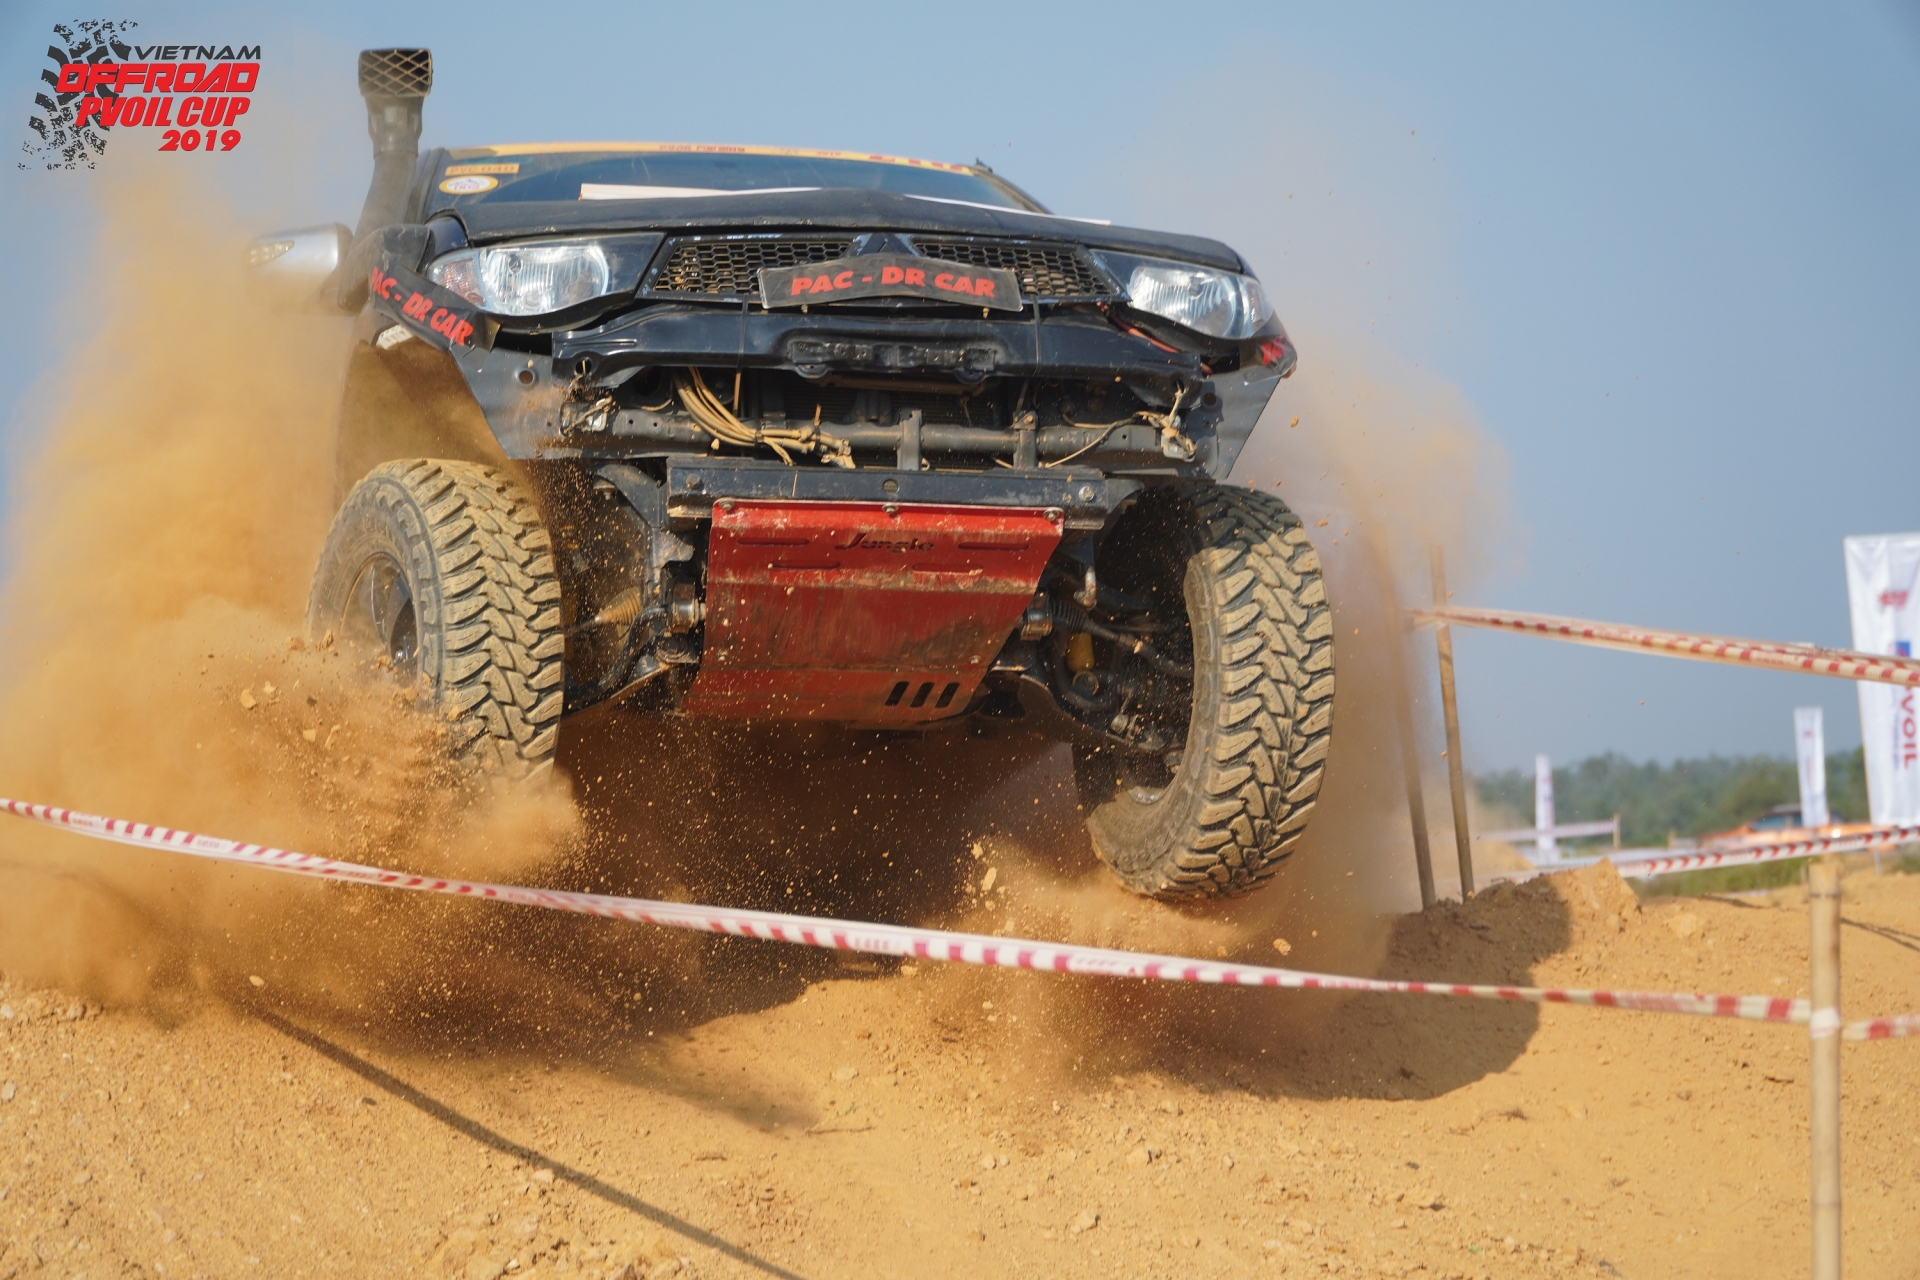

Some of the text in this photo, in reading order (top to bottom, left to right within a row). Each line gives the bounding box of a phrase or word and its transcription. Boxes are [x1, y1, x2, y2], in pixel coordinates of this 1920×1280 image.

[791, 270, 854, 296] PAC
[881, 266, 925, 287] DR
[934, 273, 995, 298] CAR
[402, 291, 433, 323] DR
[430, 307, 474, 346] CAR
[834, 532, 935, 554] Jungle
[1900, 684, 1917, 770] VOIL
